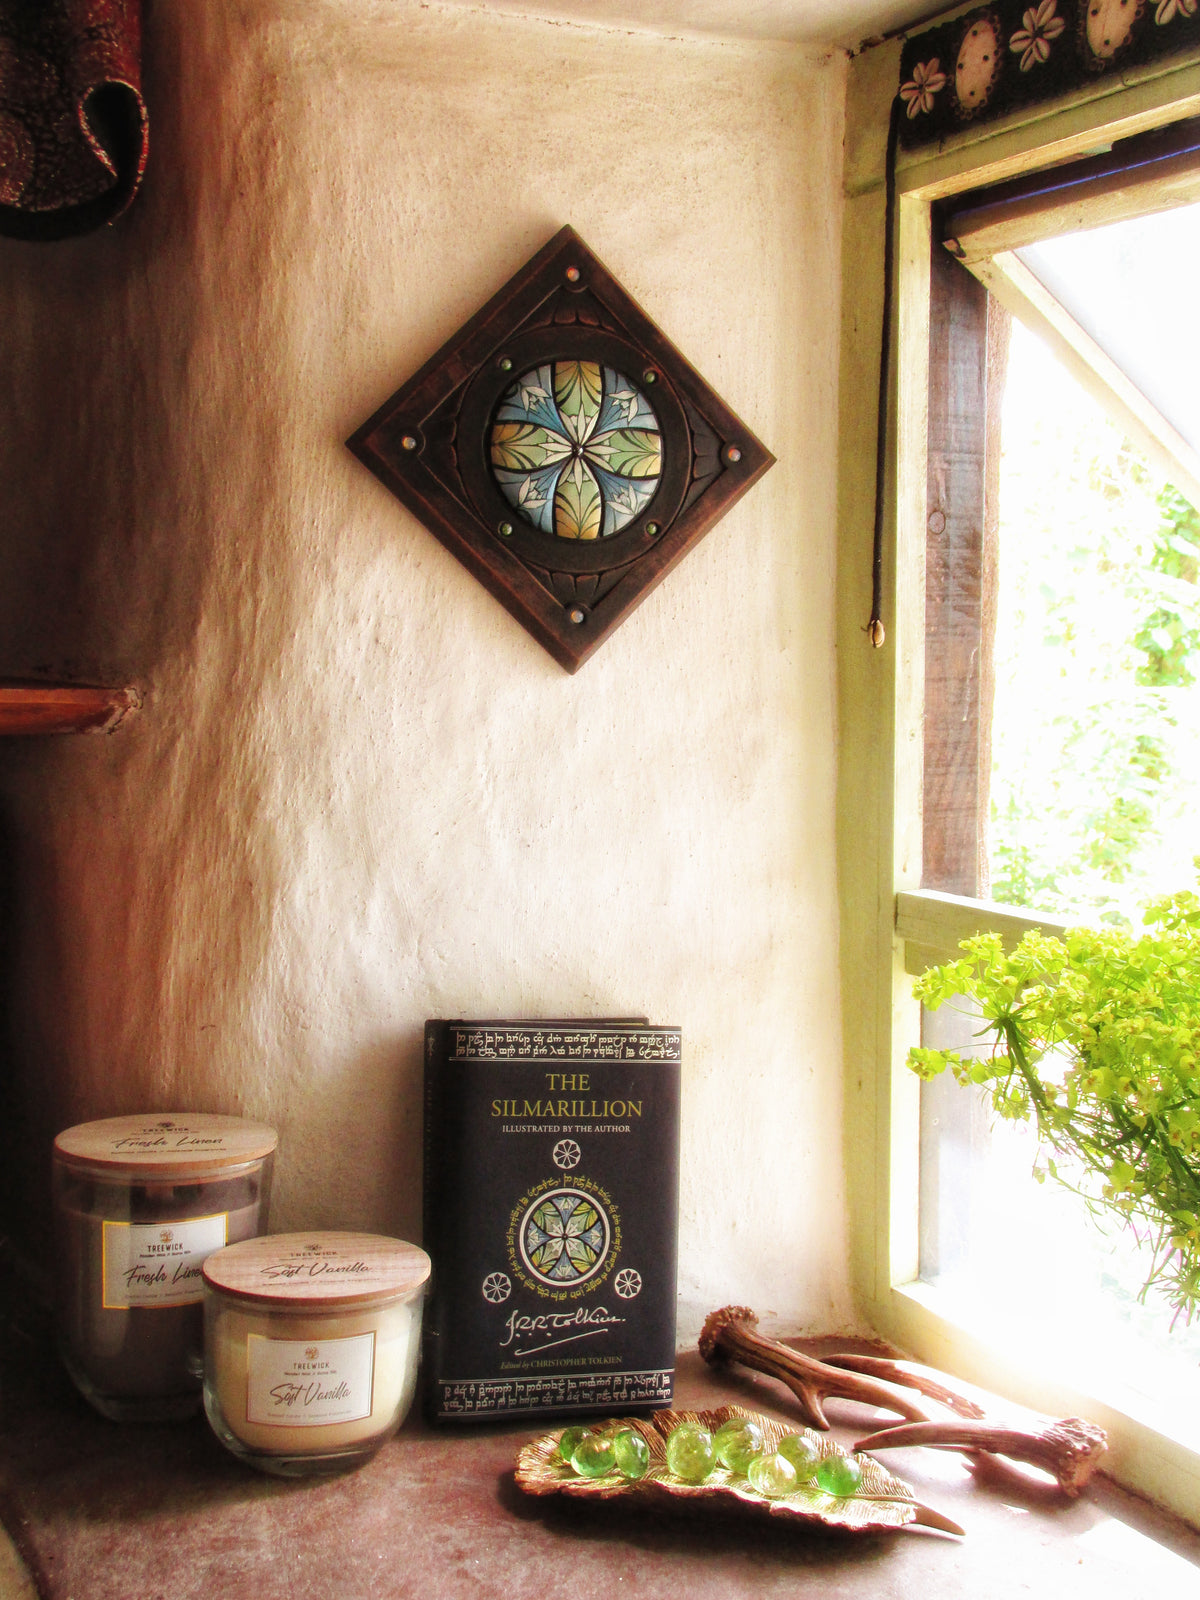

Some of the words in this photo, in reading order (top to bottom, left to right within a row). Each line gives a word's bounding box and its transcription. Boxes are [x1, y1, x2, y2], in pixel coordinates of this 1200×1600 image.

[545, 1073, 590, 1091] THE
[491, 1100, 643, 1117] SILMARILLION
[502, 1125, 561, 1133] ILLUSTRATED
[562, 1125, 574, 1133] BY
[575, 1125, 593, 1133] THE
[594, 1125, 631, 1133] AUTHOR
[147, 1243, 184, 1253] TREEWICK
[122, 1264, 167, 1288] Fresh
[171, 1262, 203, 1285] Line
[308, 1261, 370, 1277] Vanilla
[531, 1358, 587, 1369] CHRISTOPHER
[588, 1356, 622, 1365] TOLKIEN
[304, 1381, 352, 1407] Vanilla
